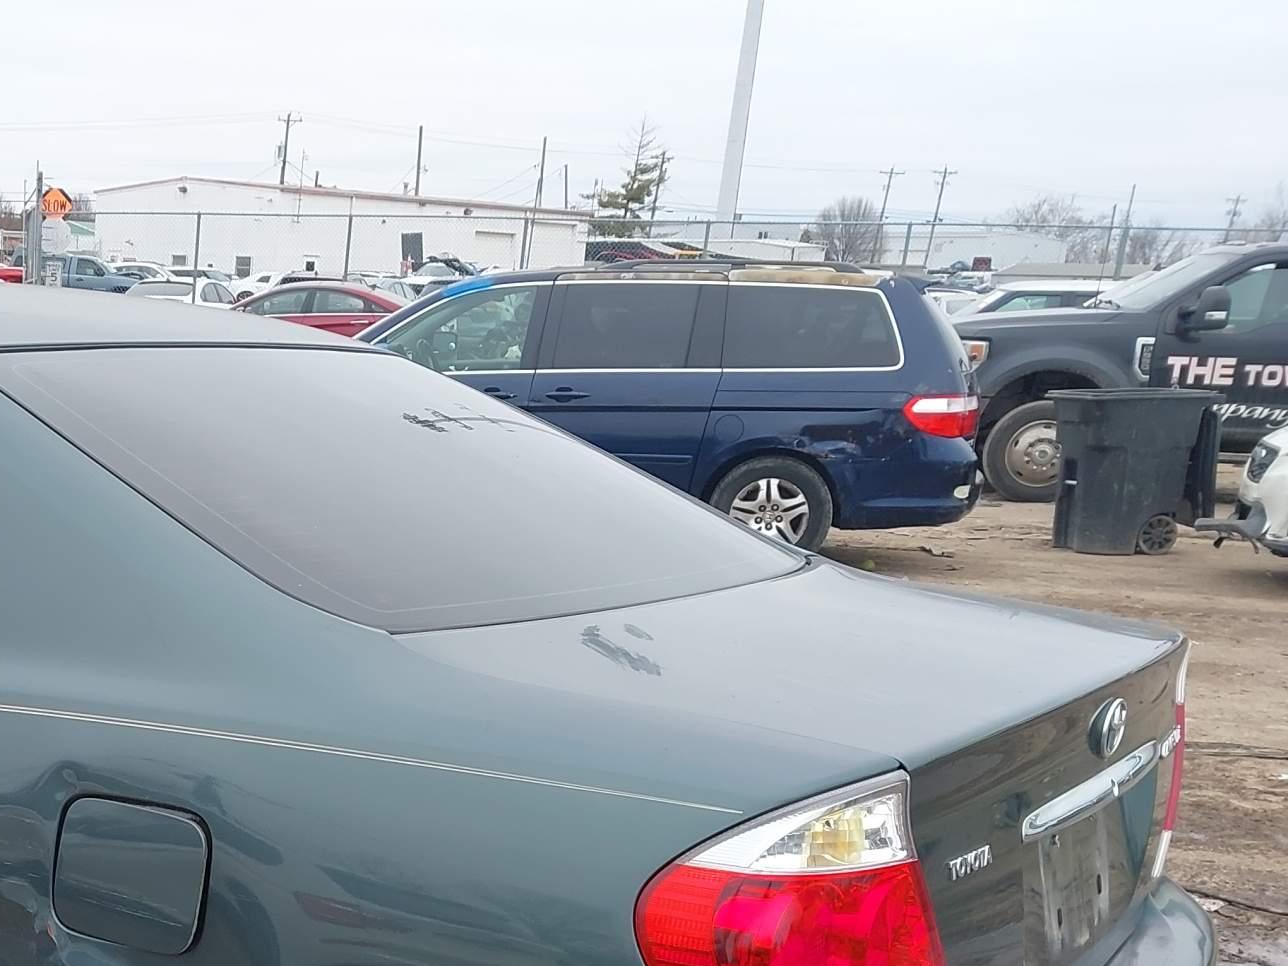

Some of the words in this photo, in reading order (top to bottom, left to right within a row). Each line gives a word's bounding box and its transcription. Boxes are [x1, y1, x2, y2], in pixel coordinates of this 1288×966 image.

[42, 200, 67, 212] SLOW
[1167, 356, 1238, 385] THE
[1244, 364, 1288, 386] TO
[947, 844, 992, 880] TOYOTA
